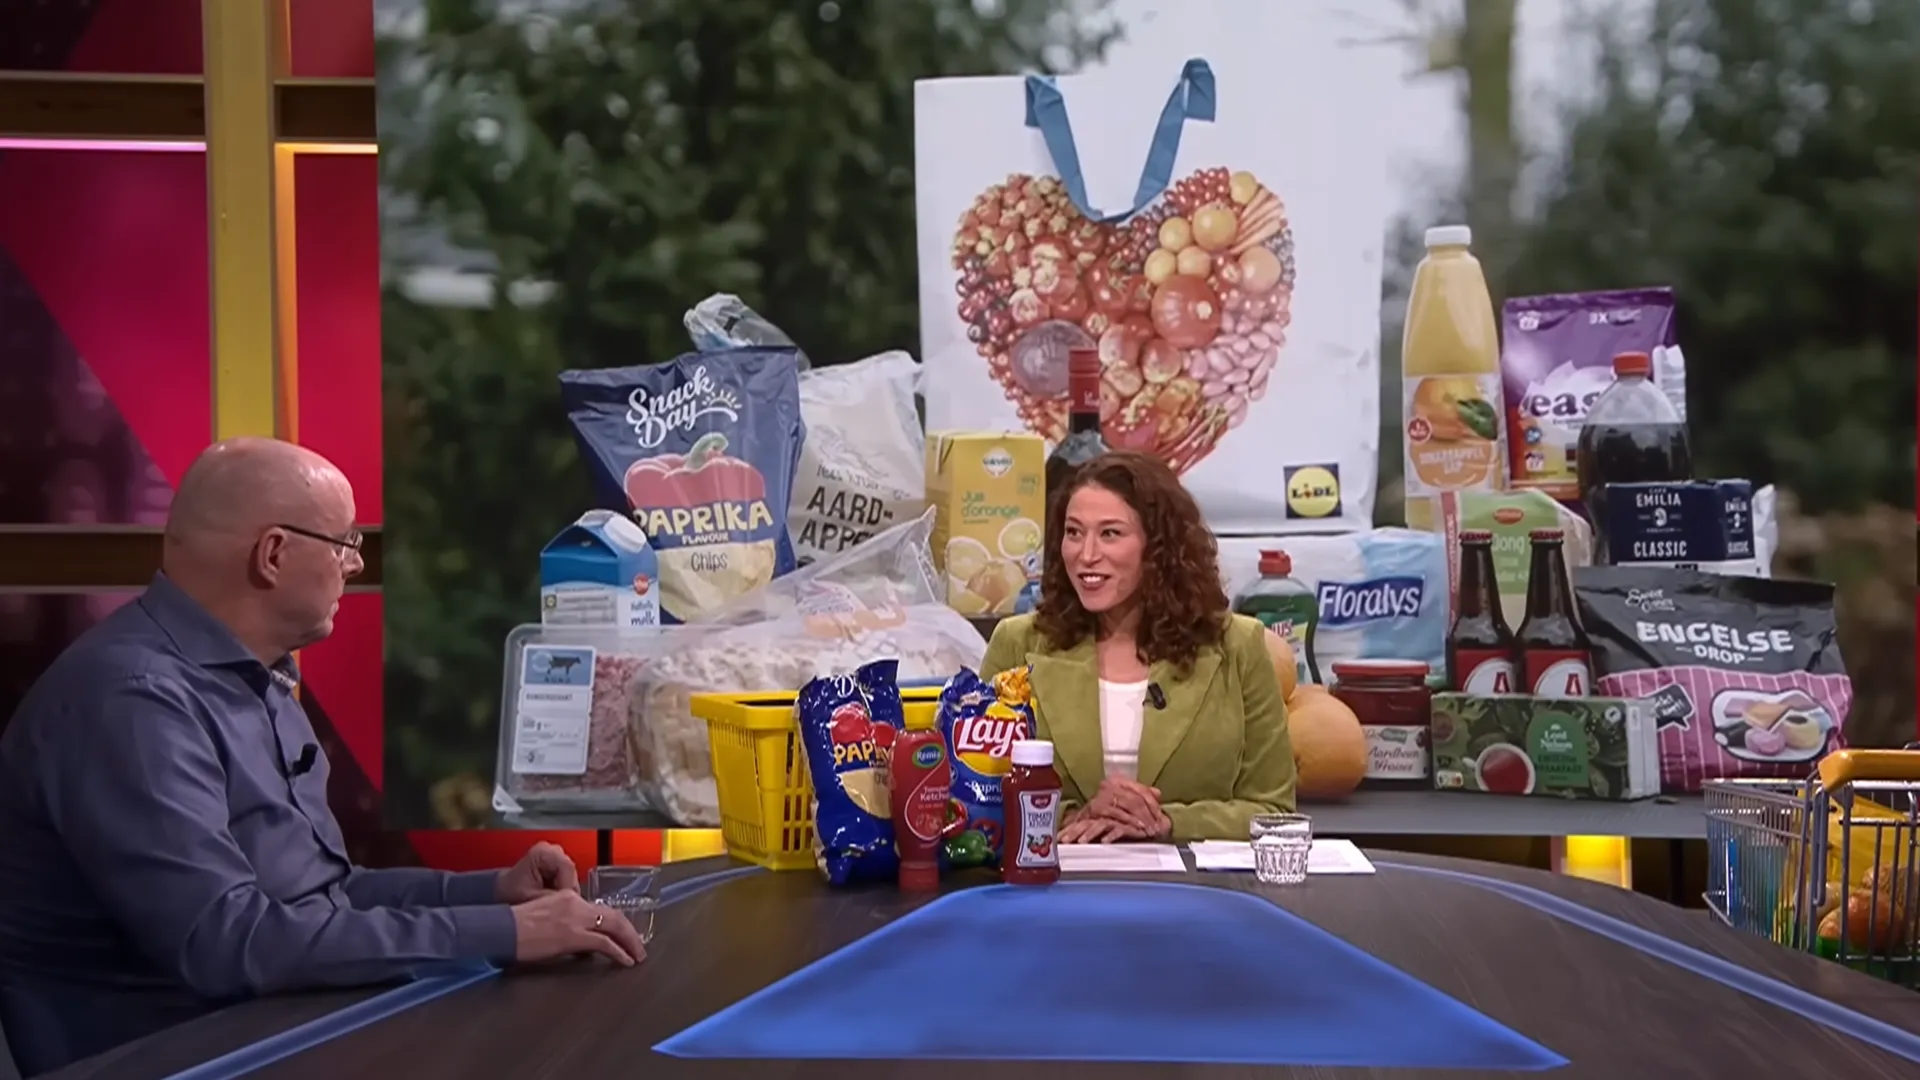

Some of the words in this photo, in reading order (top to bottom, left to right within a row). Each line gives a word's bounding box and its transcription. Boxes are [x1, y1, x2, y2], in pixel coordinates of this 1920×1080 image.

[626, 365, 715, 425] Snack
[1530, 391, 1600, 417] eas
[634, 398, 728, 449] Day
[806, 485, 893, 526] AARD-
[1636, 493, 1681, 507] EMILIA
[632, 500, 774, 537] PAPRIKA
[681, 532, 729, 545] FLAVOUR
[1633, 540, 1687, 558] CLASSIC
[690, 551, 728, 573] Chips
[1319, 583, 1420, 618] Floralys
[1636, 621, 1794, 653] ENGELSE
[1694, 645, 1745, 664] DROP
[957, 717, 1027, 757] Lay's
